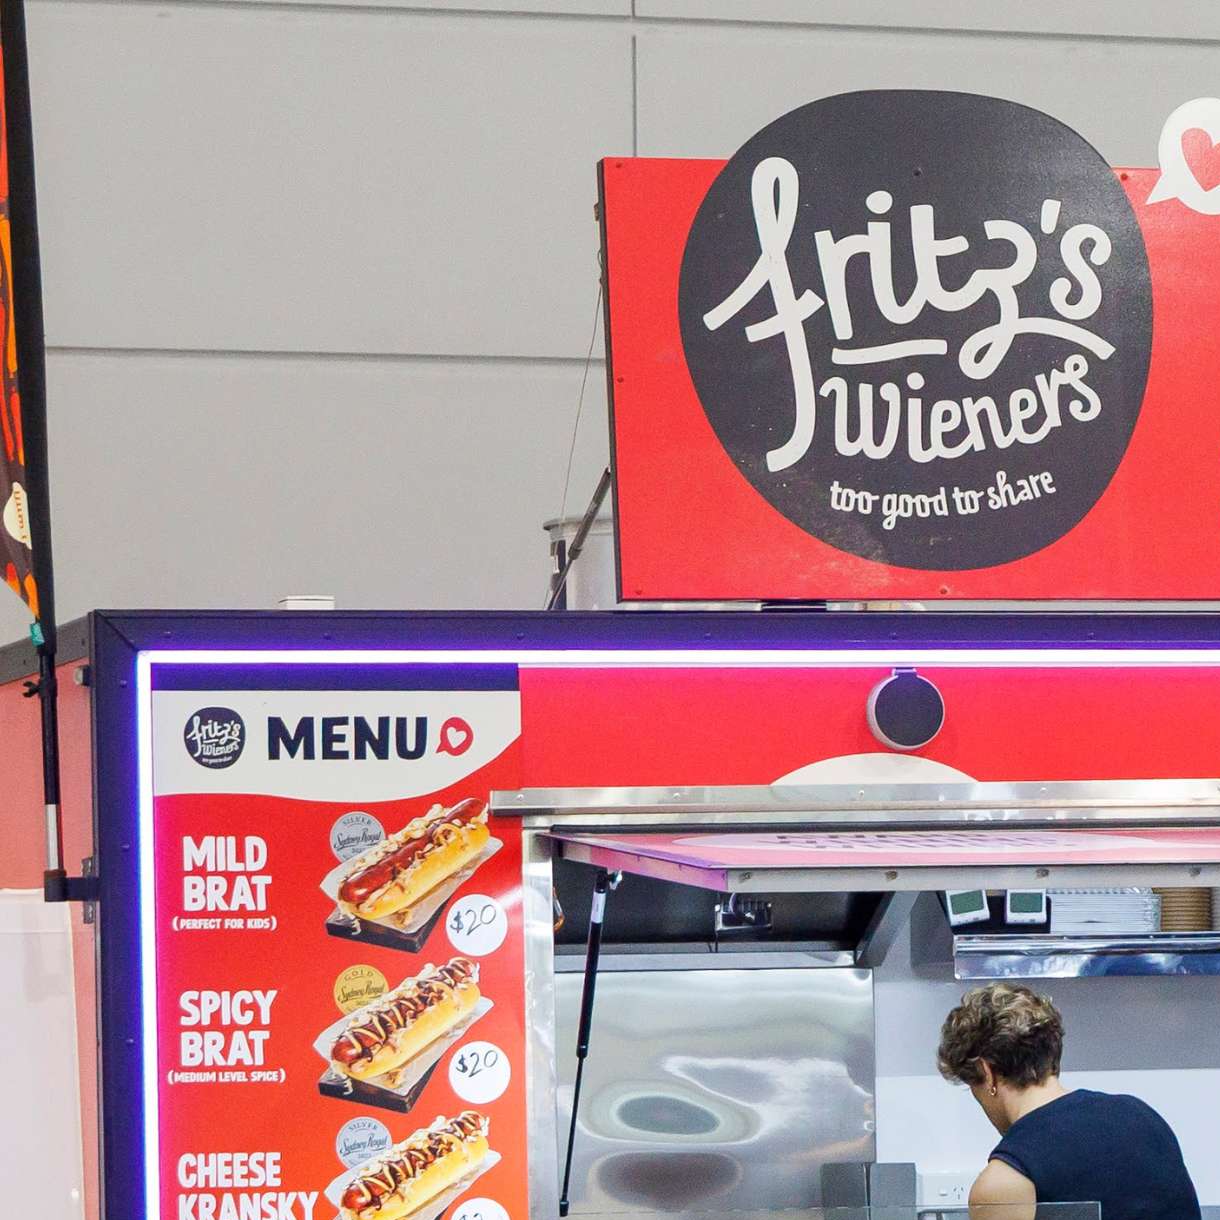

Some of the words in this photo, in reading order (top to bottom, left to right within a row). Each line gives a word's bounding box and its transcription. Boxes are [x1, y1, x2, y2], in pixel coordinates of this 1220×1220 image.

[830, 481, 880, 515] too
[882, 487, 949, 530] good
[952, 486, 985, 515] to
[986, 470, 1057, 511] share
[267, 716, 428, 760] MENU
[183, 836, 268, 872] MILD
[183, 875, 273, 911] BRAT
[172, 916, 222, 931] (PERFECT
[224, 918, 244, 929] FOR
[247, 915, 277, 931] KIDS)
[450, 904, 496, 935] $20
[180, 990, 278, 1026] SPICY
[181, 1030, 271, 1066] BRAT
[455, 1049, 499, 1078] $20
[219, 1071, 248, 1083] LEVEL
[251, 1068, 286, 1083] SPICE)
[178, 1152, 282, 1188] CHEESE
